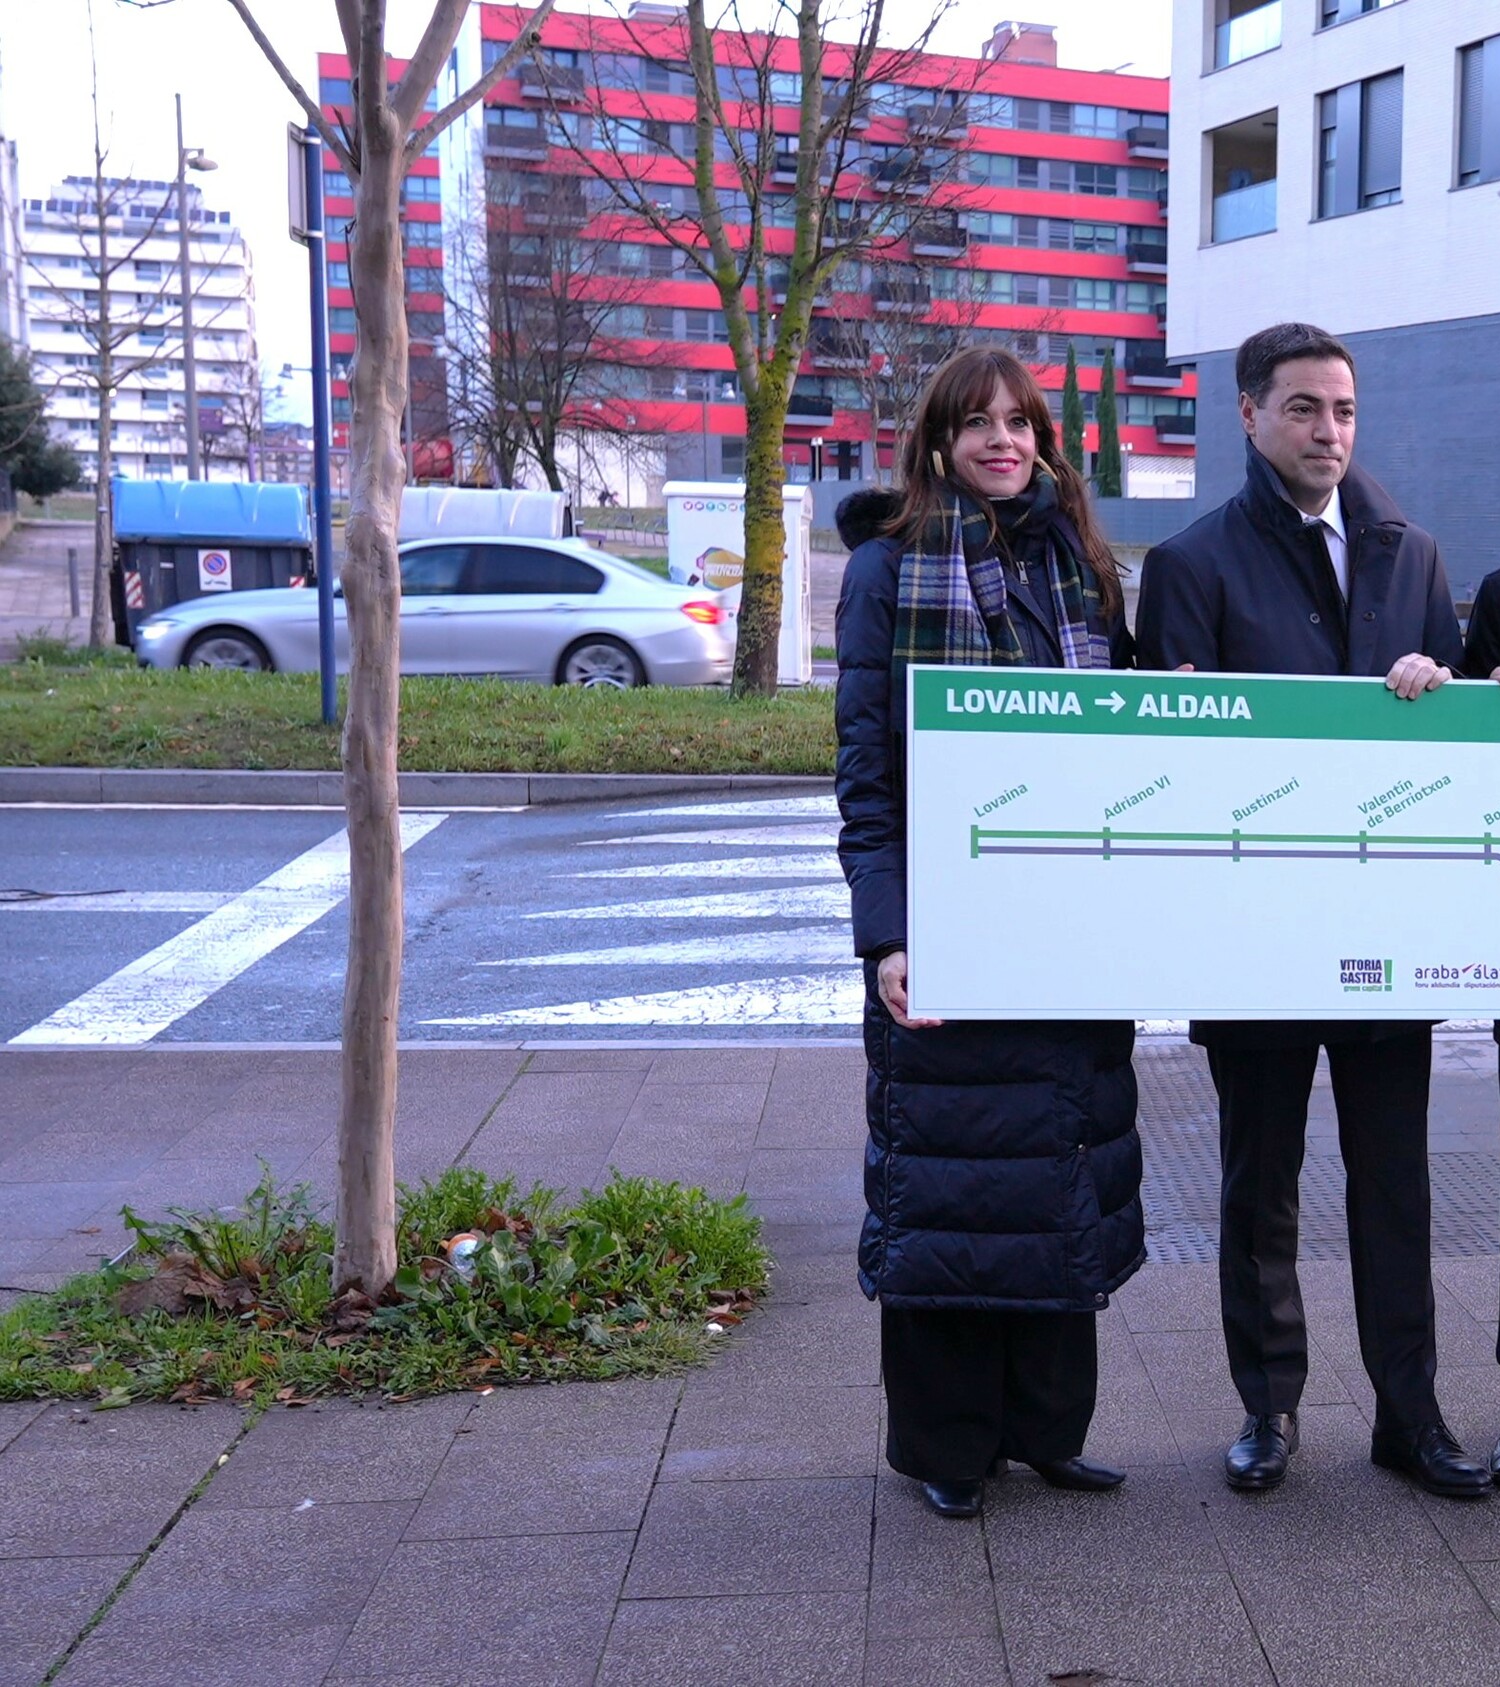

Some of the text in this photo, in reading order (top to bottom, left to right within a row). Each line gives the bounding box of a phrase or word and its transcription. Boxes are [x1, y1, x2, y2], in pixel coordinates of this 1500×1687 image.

[947, 688, 1252, 720] LOVAINA ALDAIA
[973, 783, 1028, 818] Lovaina
[1103, 775, 1172, 820] Adriano VI
[1231, 776, 1300, 822] Bustinzuri
[1357, 778, 1414, 815] Valentín
[1366, 775, 1452, 828] de Berriotxoa
[1340, 959, 1382, 971] VITORIA
[1340, 972, 1382, 984] GASTEIZ
[1415, 964, 1459, 979] araba
